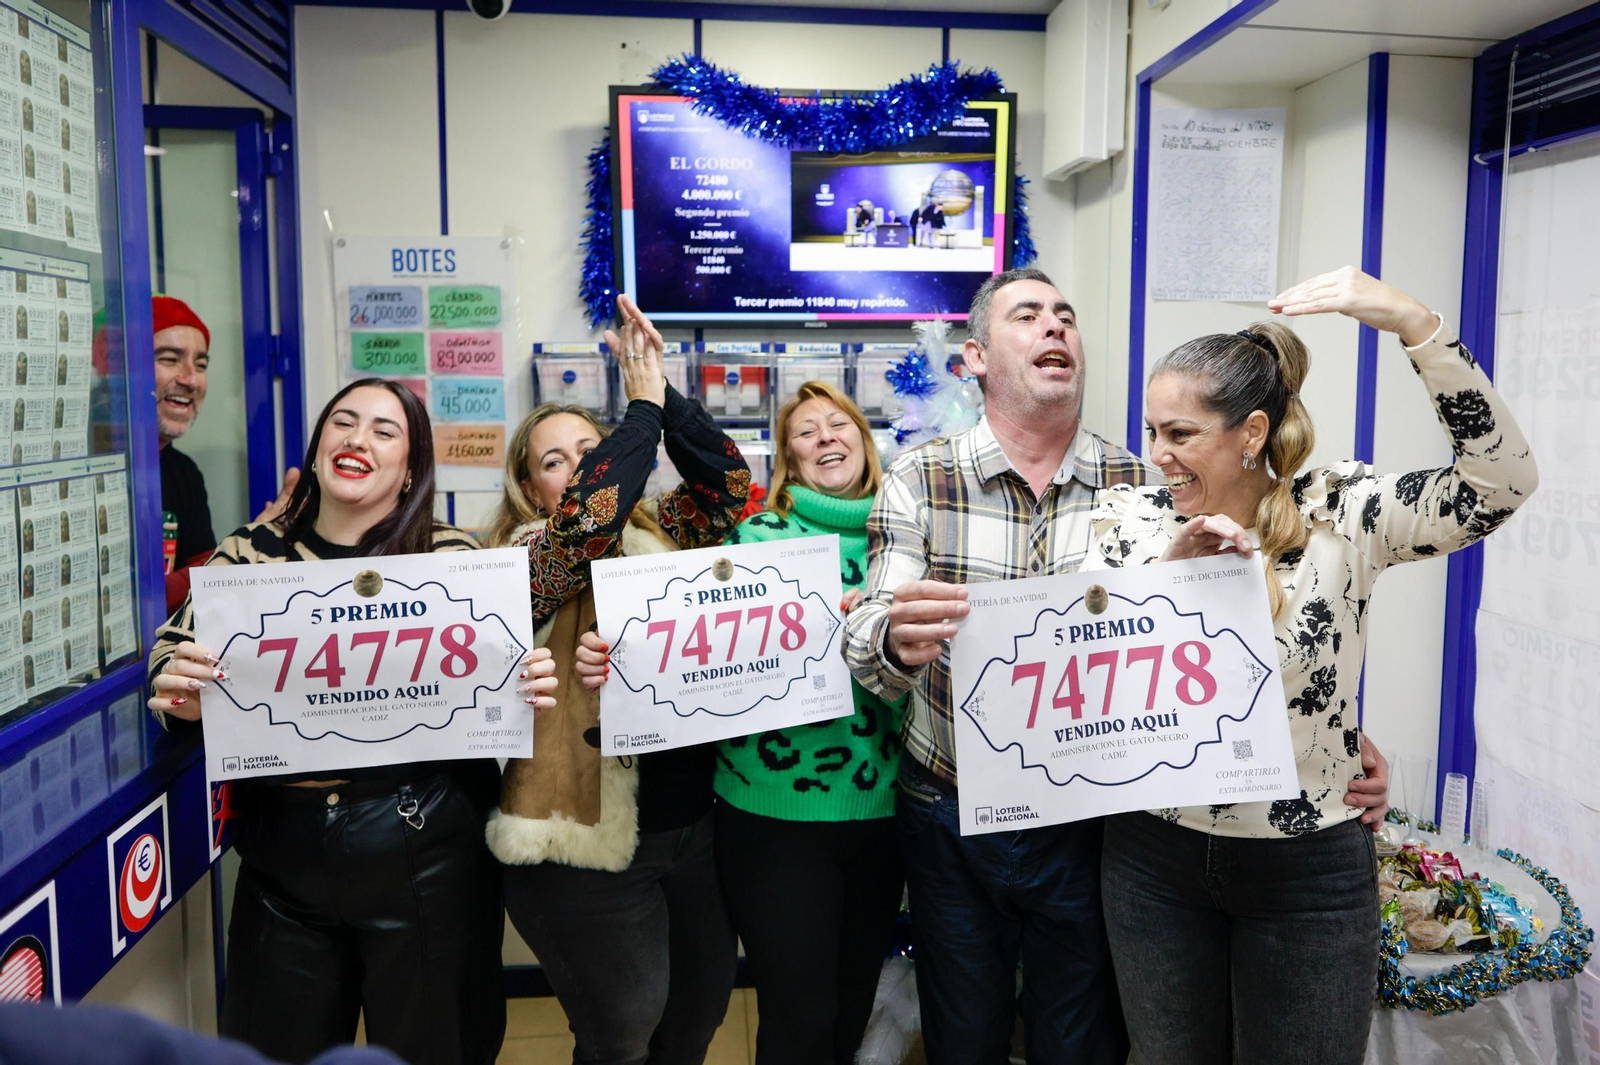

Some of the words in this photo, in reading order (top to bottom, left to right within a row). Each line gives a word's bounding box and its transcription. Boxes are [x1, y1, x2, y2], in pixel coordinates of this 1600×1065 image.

[670, 156, 691, 170] EL
[694, 156, 753, 170] GORDO
[695, 174, 729, 186] 72480
[681, 188, 733, 200] 4.000.000
[734, 189, 743, 200] €
[674, 206, 715, 219] Segundo
[716, 207, 750, 219] premio
[682, 244, 712, 254] Tercer
[713, 245, 744, 255] premio
[391, 248, 457, 273] BOTES
[734, 296, 768, 307] Tercer
[768, 296, 804, 309] premio
[805, 296, 836, 307] 11840
[836, 299, 859, 309] muy
[860, 296, 909, 308] repartido.
[797, 546, 830, 556] DICIEMBRE
[448, 565, 457, 573] 22
[459, 564, 470, 572] DE
[472, 560, 517, 571] DICIEMBRE
[600, 568, 632, 580] LOTERÍA
[633, 568, 643, 576] DE
[643, 564, 677, 575] NAVIDAD
[203, 577, 243, 588] LOTERÍA
[245, 578, 259, 586] DE
[260, 575, 305, 586] NAVIDAD
[1172, 576, 1182, 584] 22
[1183, 574, 1197, 583] DE
[1198, 567, 1250, 581] DICIEMBRE
[697, 582, 767, 606] PREMIO
[966, 596, 999, 608] OTERÍA
[1000, 596, 1012, 605] DE
[1012, 592, 1048, 604] NAVIDAD
[330, 600, 427, 623] PREMIO
[1069, 616, 1155, 644] PREMIO
[646, 601, 807, 674] 74778
[257, 623, 478, 693] 74778
[681, 663, 743, 684] VENDIDO
[746, 653, 780, 674] AQUÍ
[678, 680, 735, 697] ADMINISTRACION
[735, 678, 744, 687] EL
[744, 675, 763, 685] GATO
[763, 672, 786, 682] NEGRO
[1011, 640, 1218, 729] 74778
[305, 688, 390, 706] VENDIDO
[394, 681, 440, 700] AQUÍ
[722, 688, 743, 698] CADIZ
[800, 692, 843, 706] COMPARTIRLO
[300, 706, 377, 718] ADMINISTRACION
[379, 704, 390, 712] EL
[391, 702, 416, 711] GATO
[418, 699, 448, 709] NEGRO
[361, 714, 389, 723] CADIZ
[1053, 718, 1126, 743] VENDIDO
[1130, 708, 1180, 732] AQUÍ
[466, 729, 522, 738] COMPARTIRLO
[630, 732, 660, 742] LOTERÍA
[467, 743, 521, 751] EXTRAORDINARIO
[631, 737, 668, 748] NACIONAL
[1050, 742, 1116, 760] ADMINISTRACION
[1117, 738, 1129, 747] EL
[1129, 735, 1156, 746] GATO
[1156, 732, 1189, 743] NEGRO
[243, 754, 280, 764] LOTERÍA
[1101, 750, 1128, 761] CADIZ
[243, 761, 289, 770] NACIONAL
[1215, 766, 1281, 780] COMPARTIRLO
[1218, 783, 1282, 795] EXTRAORDINARIO
[995, 803, 1031, 816] LOTERÍA
[996, 811, 1040, 823] NACIONAL
